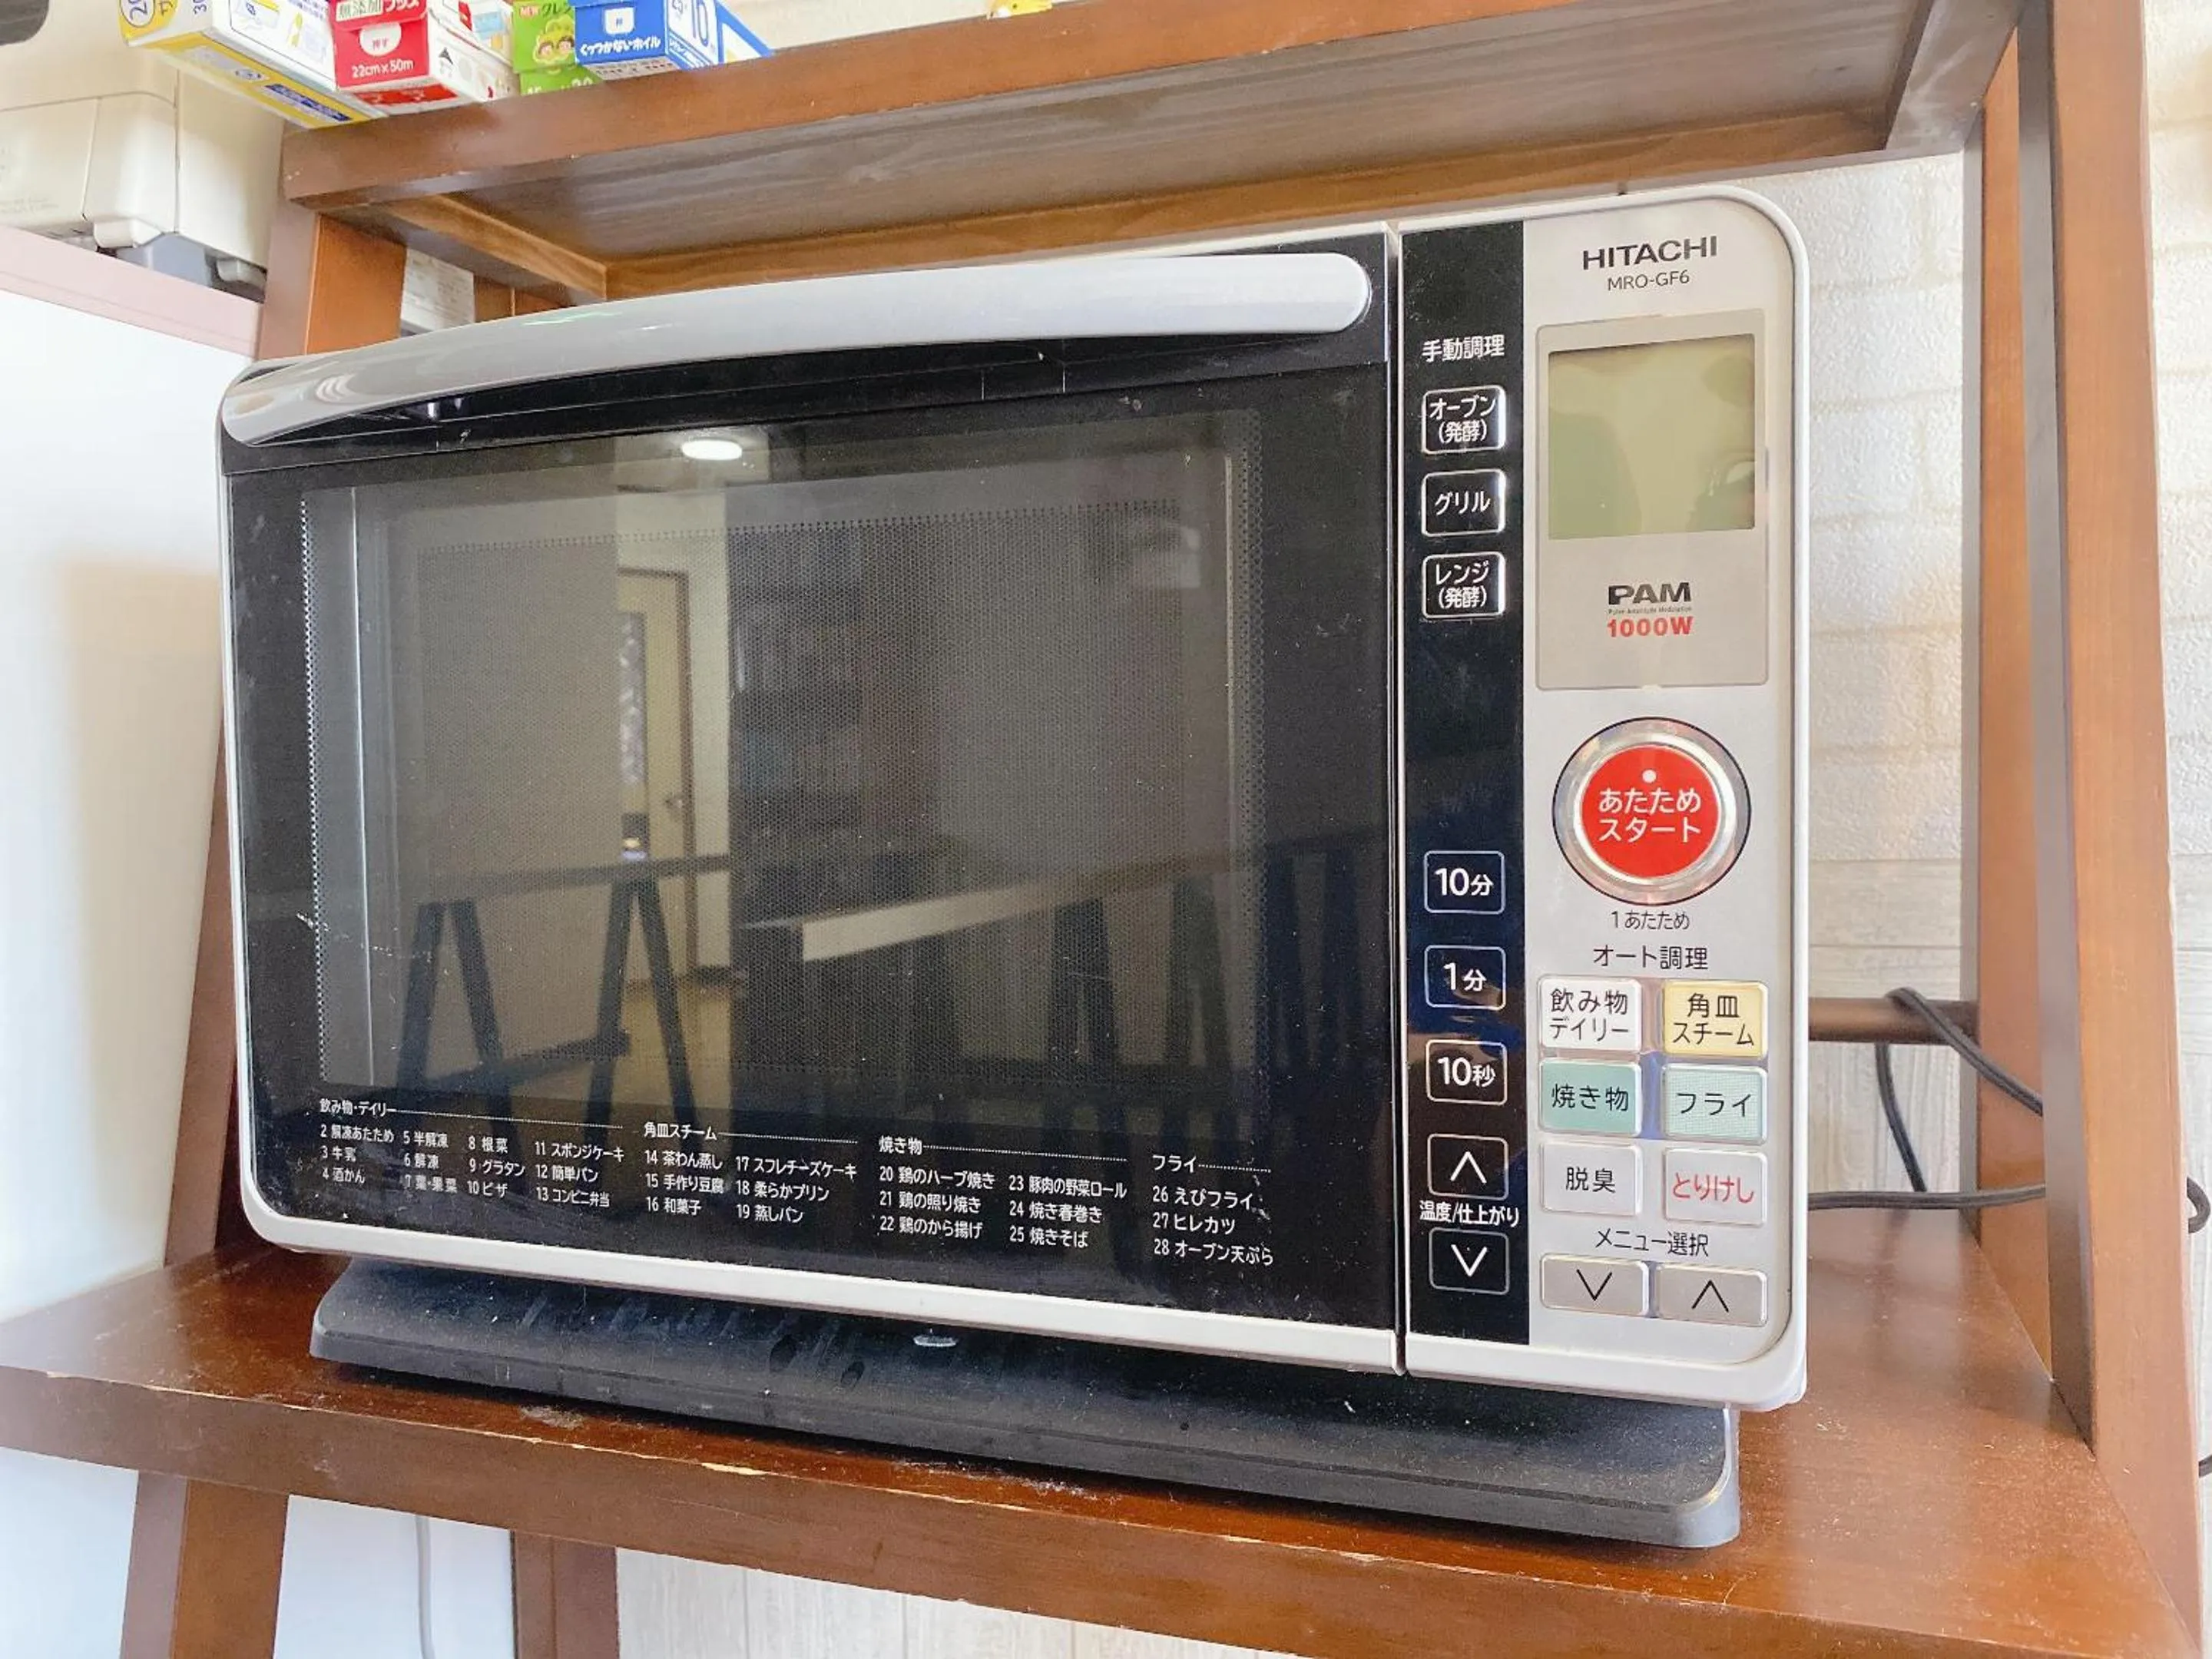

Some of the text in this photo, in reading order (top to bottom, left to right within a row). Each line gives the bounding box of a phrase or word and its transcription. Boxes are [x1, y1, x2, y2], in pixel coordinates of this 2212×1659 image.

[1582, 236, 1718, 270] HITACHI
[1608, 270, 1690, 291] MRO-GF6
[1422, 334, 1505, 363] 手動調理
[1429, 395, 1496, 420] オーブン
[1438, 419, 1487, 444] (発酵)
[1435, 490, 1491, 516] グリル
[1435, 561, 1489, 584] レンジ
[1438, 585, 1487, 610] (発酵)
[1608, 582, 1691, 604] PAM
[1608, 615, 1694, 637] 1000W
[1598, 787, 1701, 813] あたため
[1598, 817, 1701, 843] スタート
[1435, 868, 1494, 897] 10分
[1593, 945, 1708, 971] オート調理
[1444, 962, 1487, 992] 1分
[1550, 988, 1628, 1016] 飲み物
[1687, 993, 1740, 1019] 角皿
[1549, 1017, 1629, 1042] デイリー
[1672, 1022, 1754, 1047] スチーム
[1437, 1057, 1496, 1088] 10秒
[1551, 1084, 1629, 1111] 焼き物
[1678, 1092, 1752, 1118] フライ
[320, 1124, 327, 1137] 2
[403, 1131, 449, 1148] 5 半解凍
[644, 1122, 717, 1141] 角皿スチーム
[320, 1145, 356, 1162] 3 牛乳
[469, 1135, 508, 1154] 8 根菜
[535, 1142, 624, 1163] 11 スポンジケーキ
[879, 1135, 922, 1156] 焼き物
[404, 1153, 439, 1170] 6 解凍
[469, 1157, 525, 1177] 9 グラタン
[645, 1151, 723, 1170] 14 茶わん蒸し
[736, 1156, 858, 1180] 17 スフレチーズケーキ
[1154, 1154, 1197, 1174] フライ
[322, 1167, 365, 1184] 4 酒かん
[536, 1164, 598, 1183] 12 簡単パン
[646, 1174, 724, 1194] 15 手作り豆腐
[879, 1166, 995, 1190] 20 鶏のハーブ焼き
[1565, 1167, 1617, 1194] 脱臭
[467, 1180, 480, 1195] 10
[536, 1187, 610, 1207] 13 コンビニ弁当
[736, 1181, 750, 1196] 18
[1009, 1175, 1128, 1200] 23 豚肉の野菜ロール
[1153, 1187, 1254, 1211] 26 えびフライ
[1672, 1172, 1754, 1204] とりけし
[646, 1197, 702, 1217] 16 和菓子
[737, 1204, 804, 1224] 19 蒸しパン
[879, 1191, 982, 1215] 21 鶏の照り焼き
[1010, 1200, 1103, 1224] 24 焼き春巻き
[1419, 1199, 1520, 1228] 温度/仕上がり
[879, 1216, 982, 1240] 22 鶏のから揚げ
[1153, 1213, 1236, 1235] 27 ヒレカツ
[1010, 1227, 1089, 1248] 25 焼きそば
[1595, 1227, 1709, 1257] メニュー選択
[1154, 1238, 1274, 1267] 28 オーブン天ぷら
